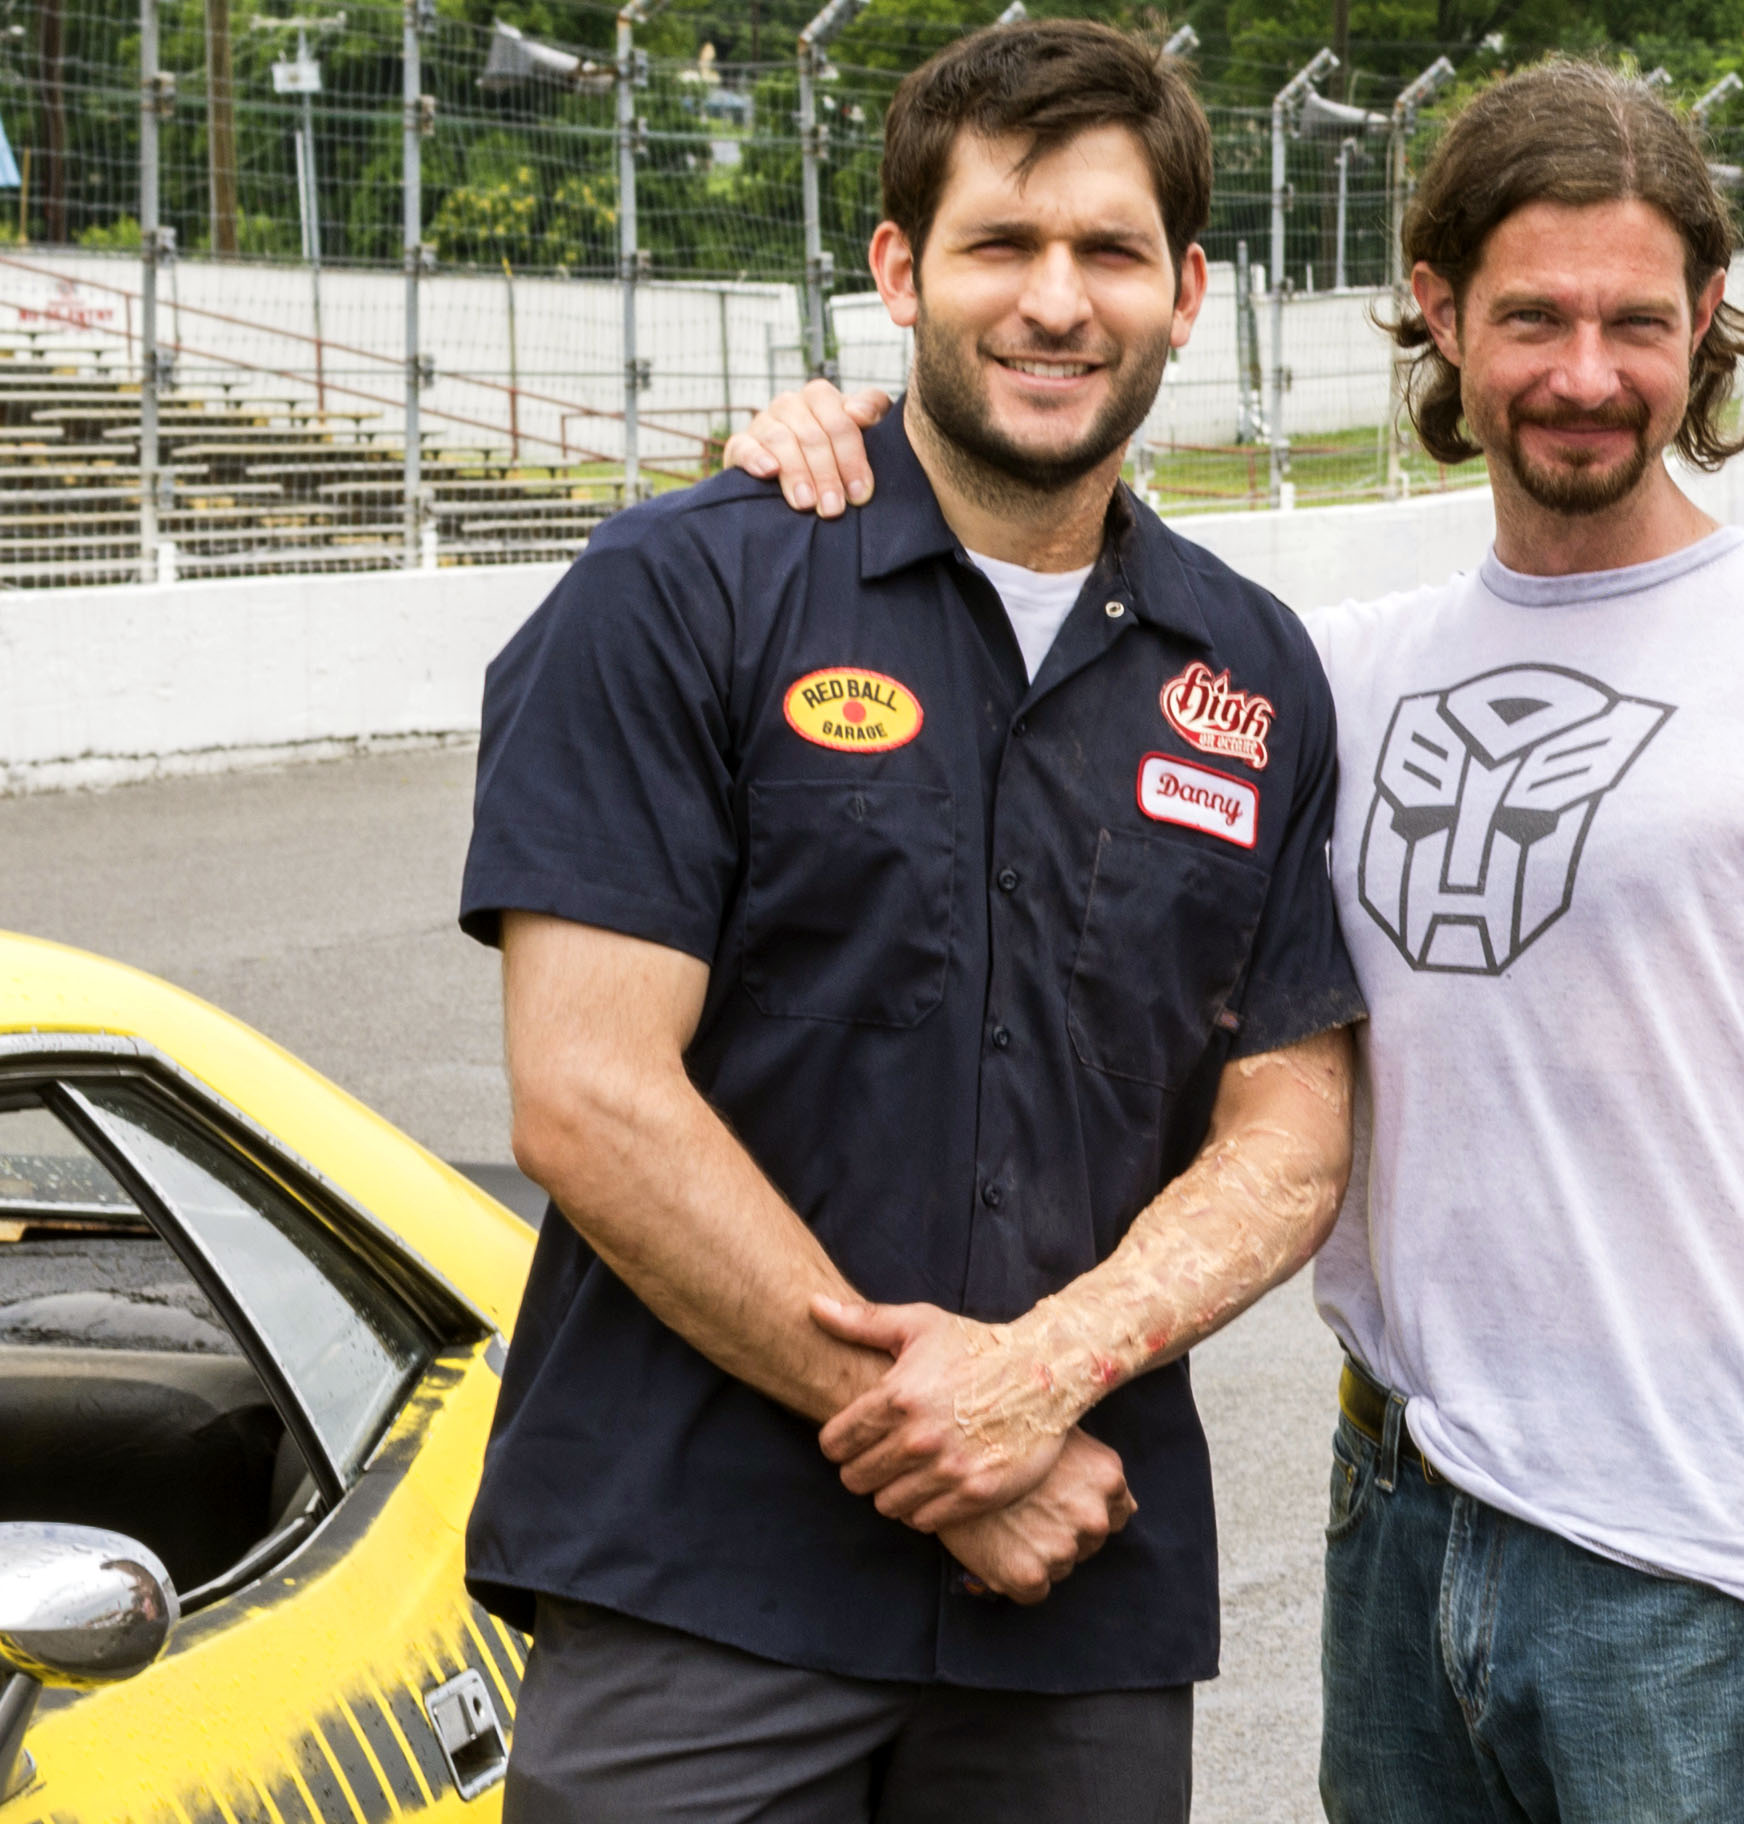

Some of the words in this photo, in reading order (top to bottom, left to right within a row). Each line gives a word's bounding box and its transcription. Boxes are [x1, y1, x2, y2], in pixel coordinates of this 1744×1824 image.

[802, 680, 844, 709] RED
[848, 679, 897, 712] BALL
[822, 720, 888, 740] GARAGE
[1157, 772, 1243, 827] Danny
